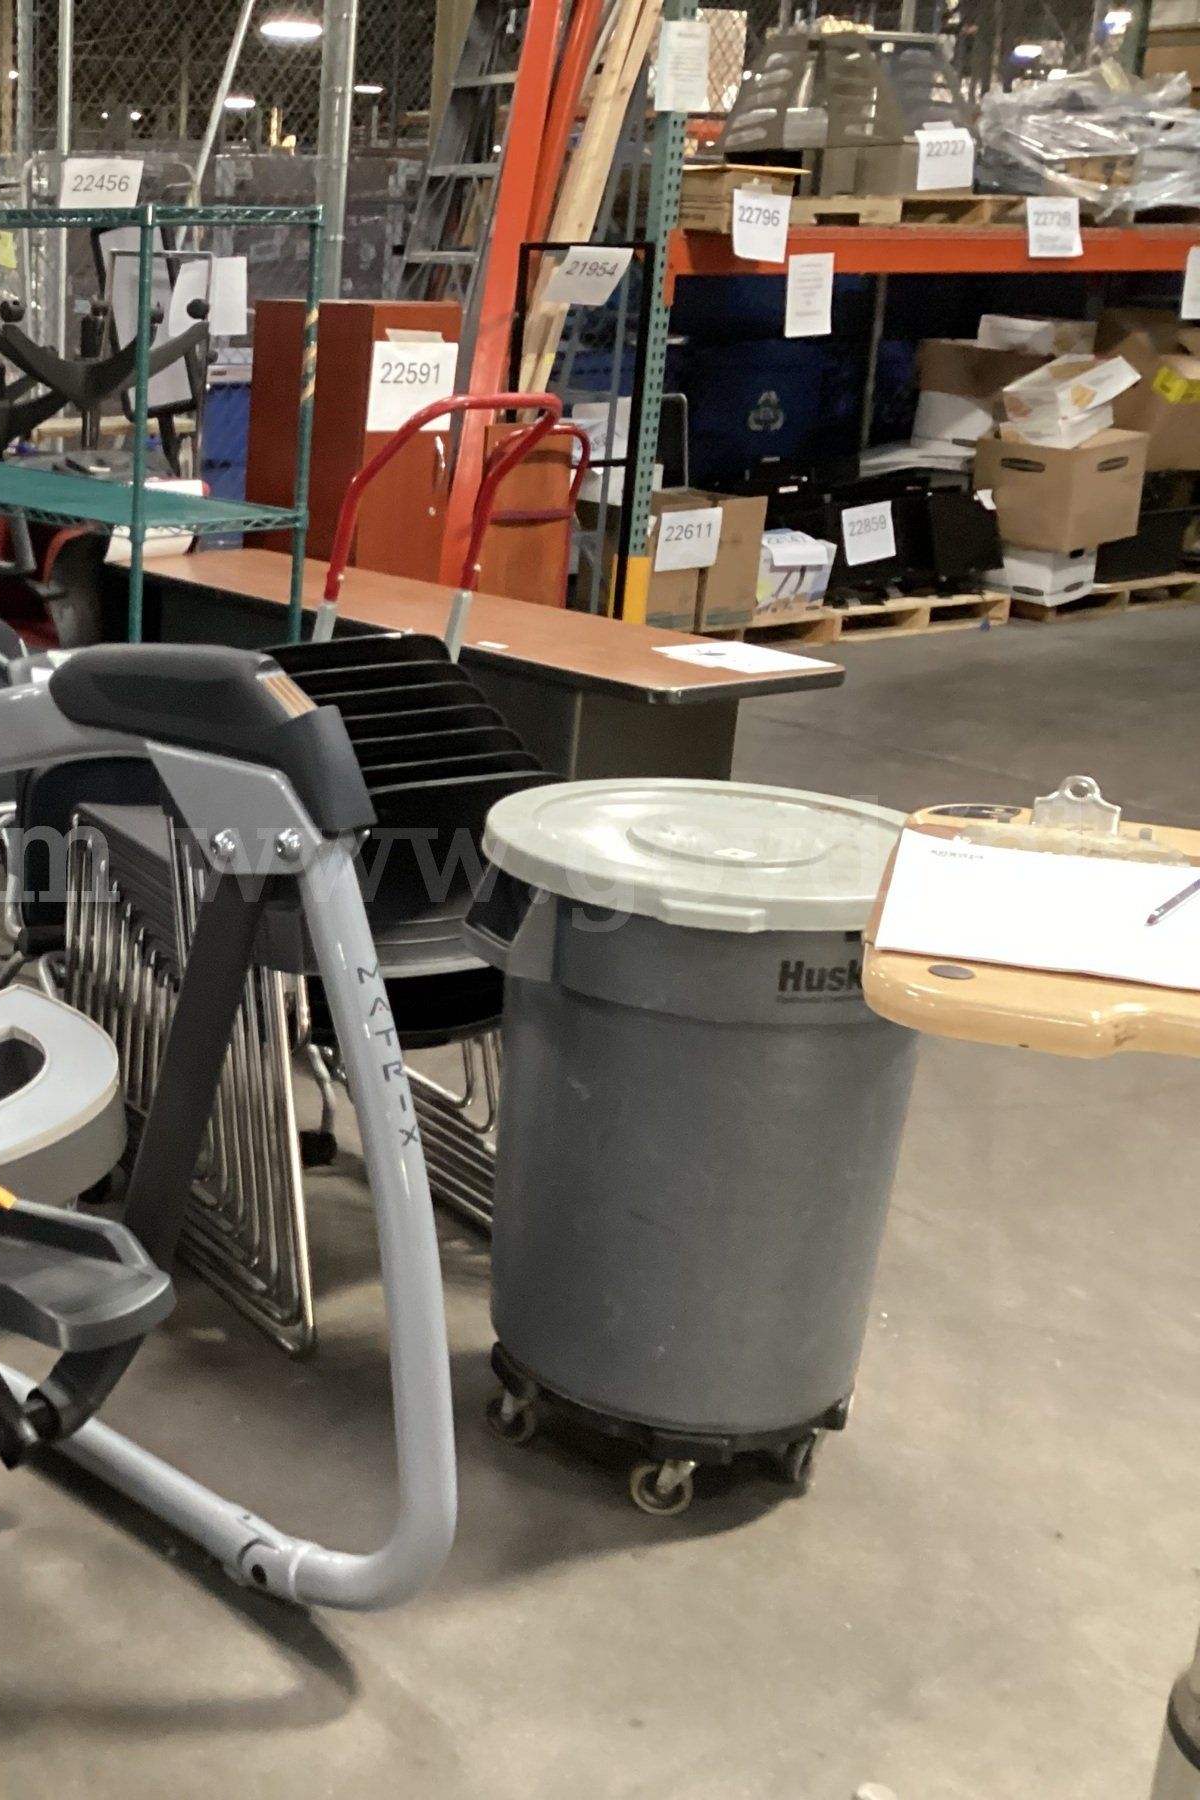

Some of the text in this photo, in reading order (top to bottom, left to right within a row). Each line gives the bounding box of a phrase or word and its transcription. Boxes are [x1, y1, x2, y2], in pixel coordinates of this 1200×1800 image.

[926, 139, 967, 157] 22727
[71, 174, 131, 192] 22456
[737, 205, 781, 227] 22796
[565, 260, 619, 277] 21954
[380, 361, 441, 384] 22591
[664, 523, 713, 542] 22611
[848, 514, 887, 537] 22859
[357, 961, 419, 1147] MATRIX
